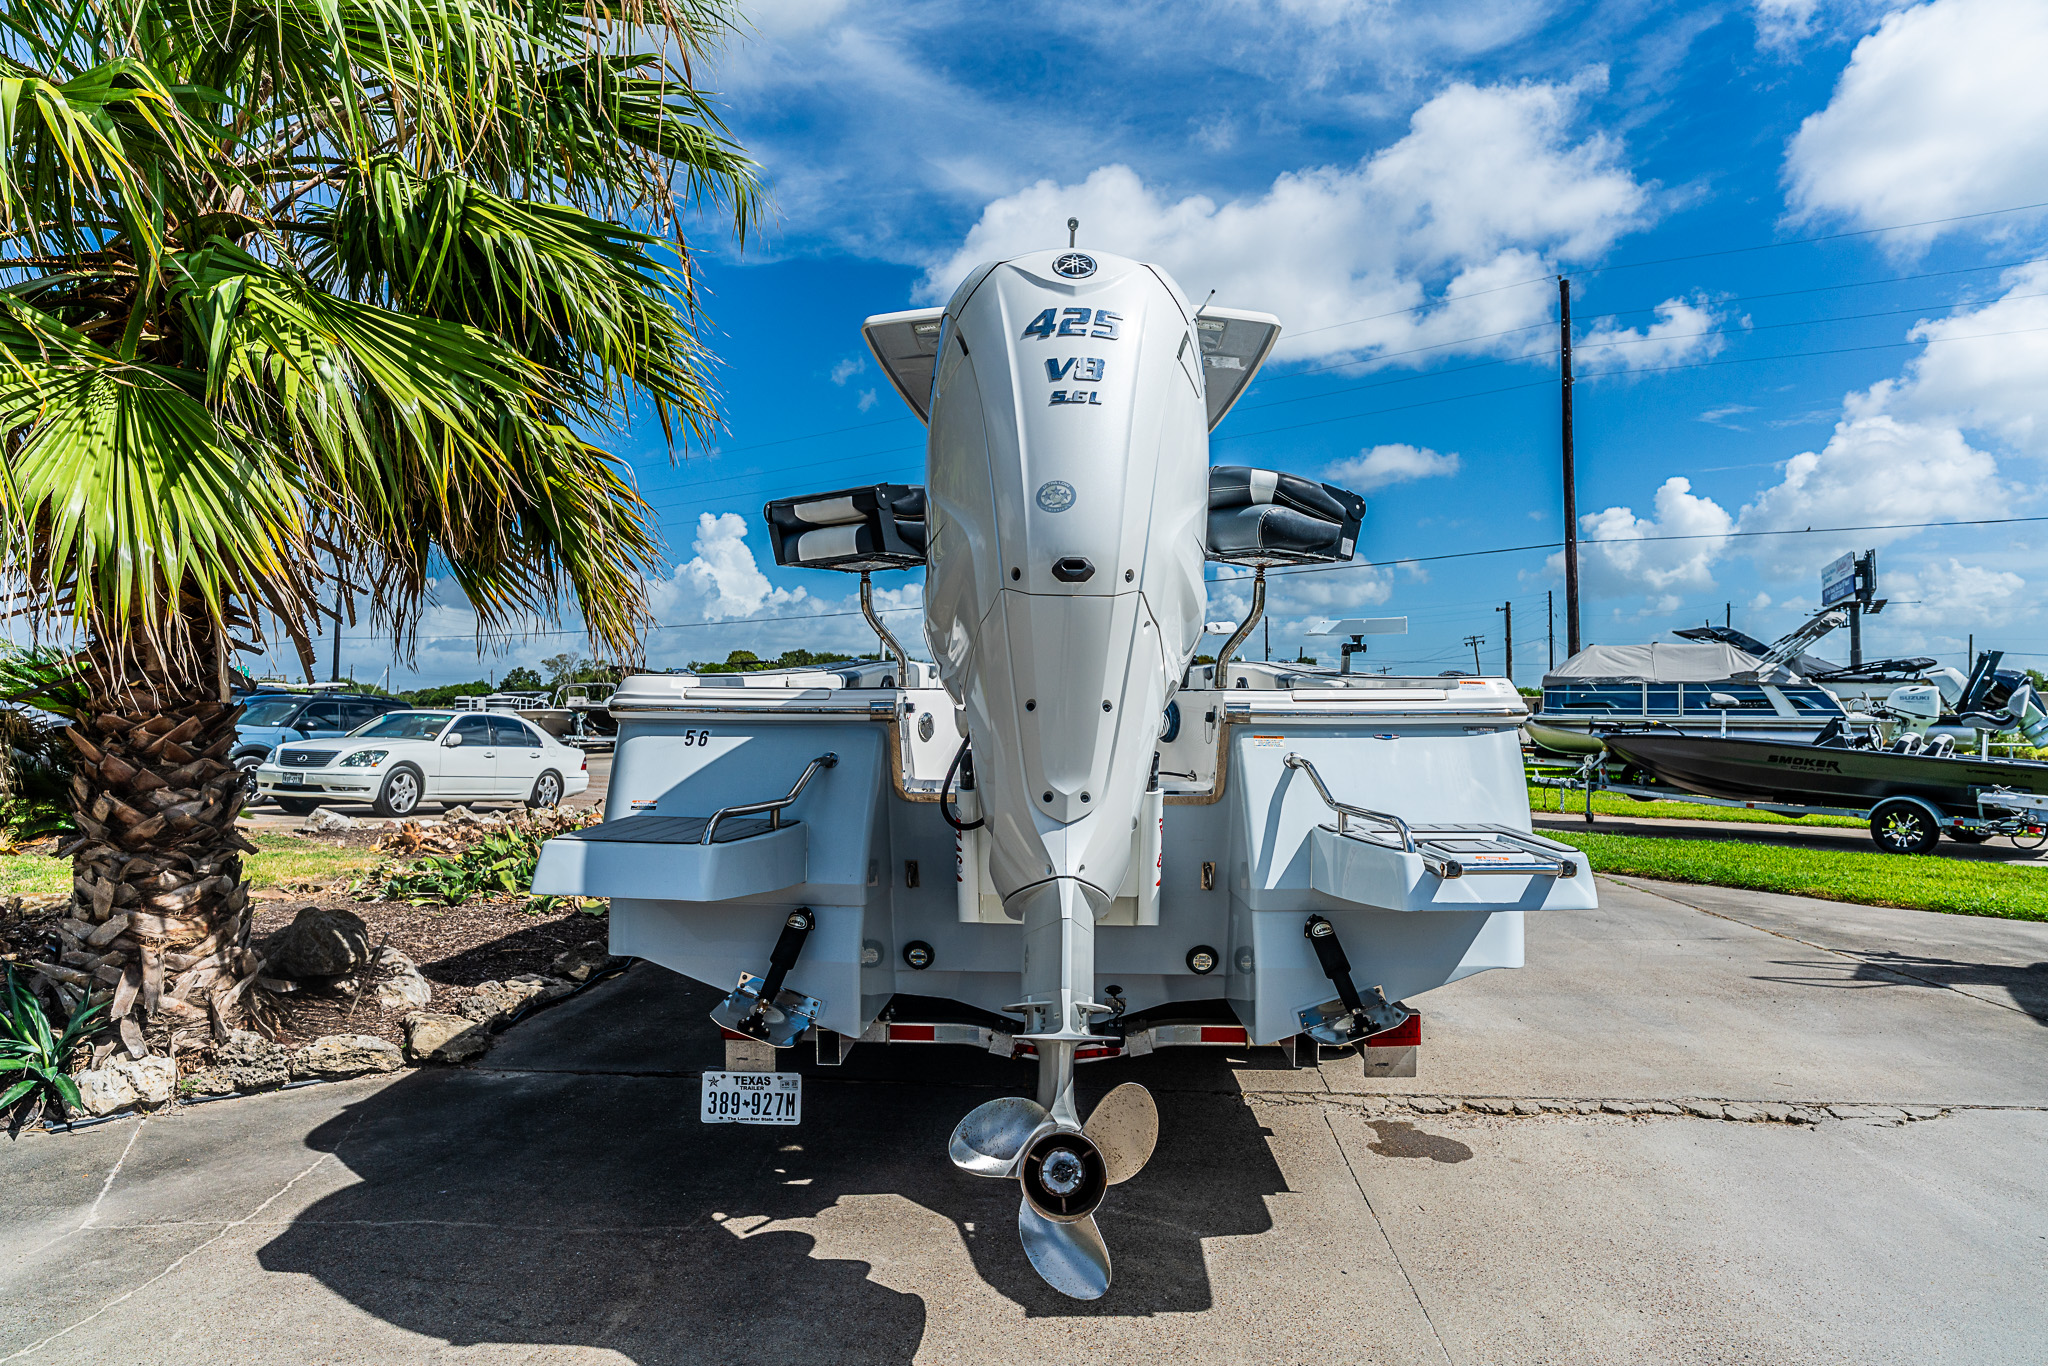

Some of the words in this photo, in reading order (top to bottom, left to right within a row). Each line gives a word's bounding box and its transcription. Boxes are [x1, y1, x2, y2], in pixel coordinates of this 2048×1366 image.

[1023, 307, 1124, 341] 425
[1045, 357, 1106, 382] V8
[1767, 755, 1842, 774] SMOKER
[1791, 765, 1832, 773] CRAFT
[733, 1076, 771, 1086] TEXAS
[708, 1091, 740, 1115] 389
[751, 1092, 796, 1116] 927M
